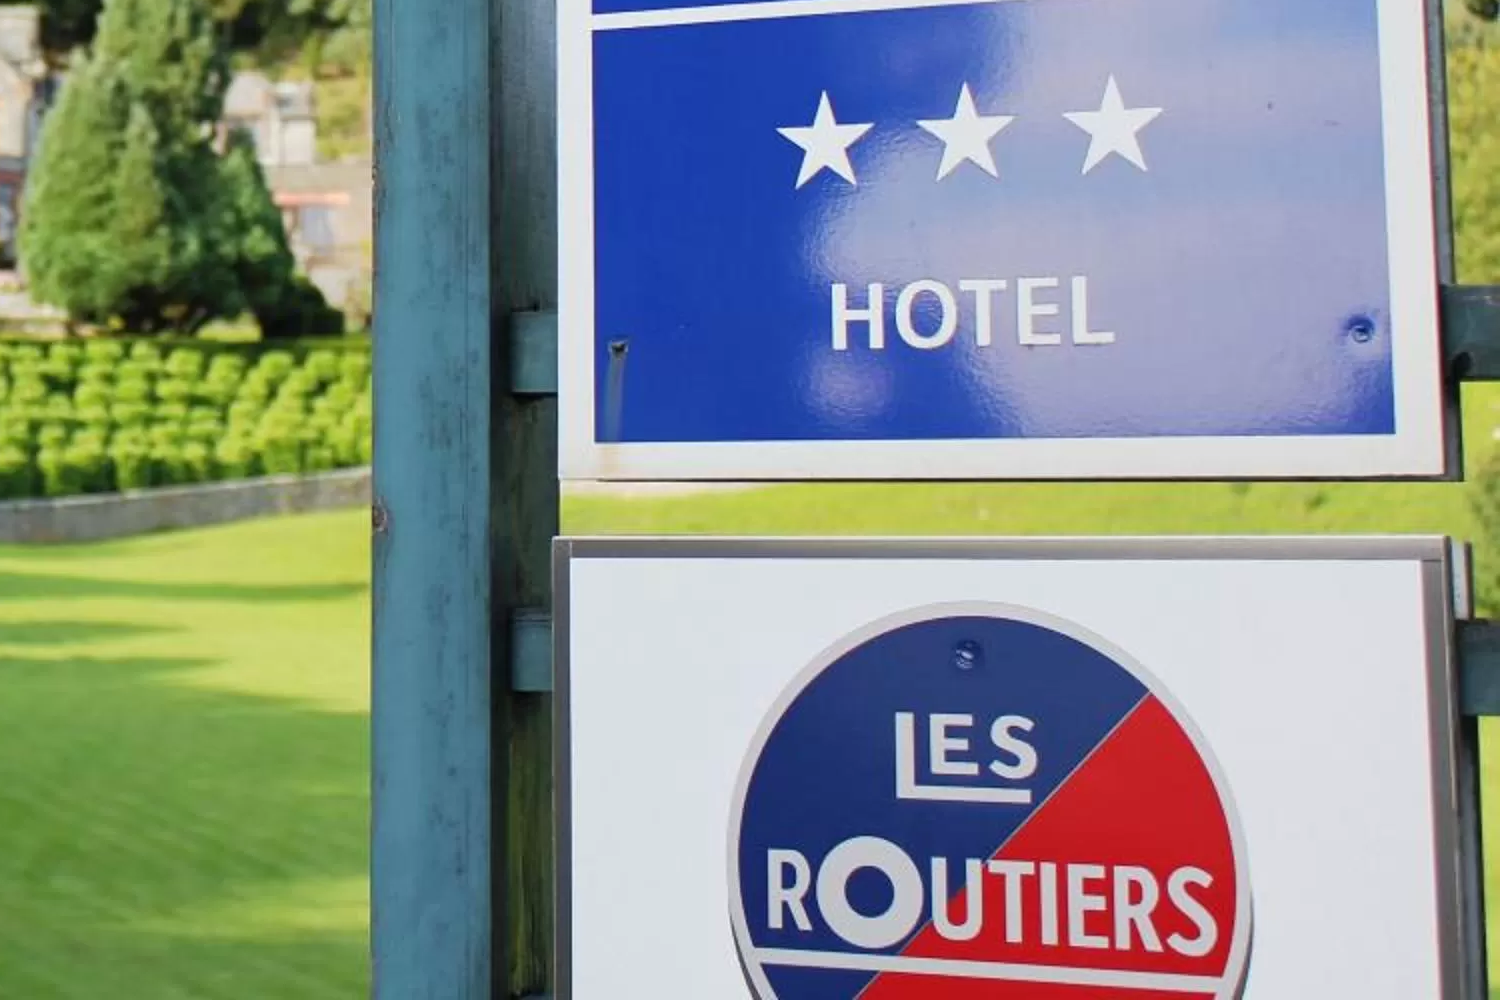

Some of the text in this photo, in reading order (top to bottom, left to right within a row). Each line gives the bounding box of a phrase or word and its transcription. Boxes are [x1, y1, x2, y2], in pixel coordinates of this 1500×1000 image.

[830, 275, 1116, 351] HOTEL
[895, 711, 1039, 803] LES
[766, 834, 1219, 957] ROUTIERS
